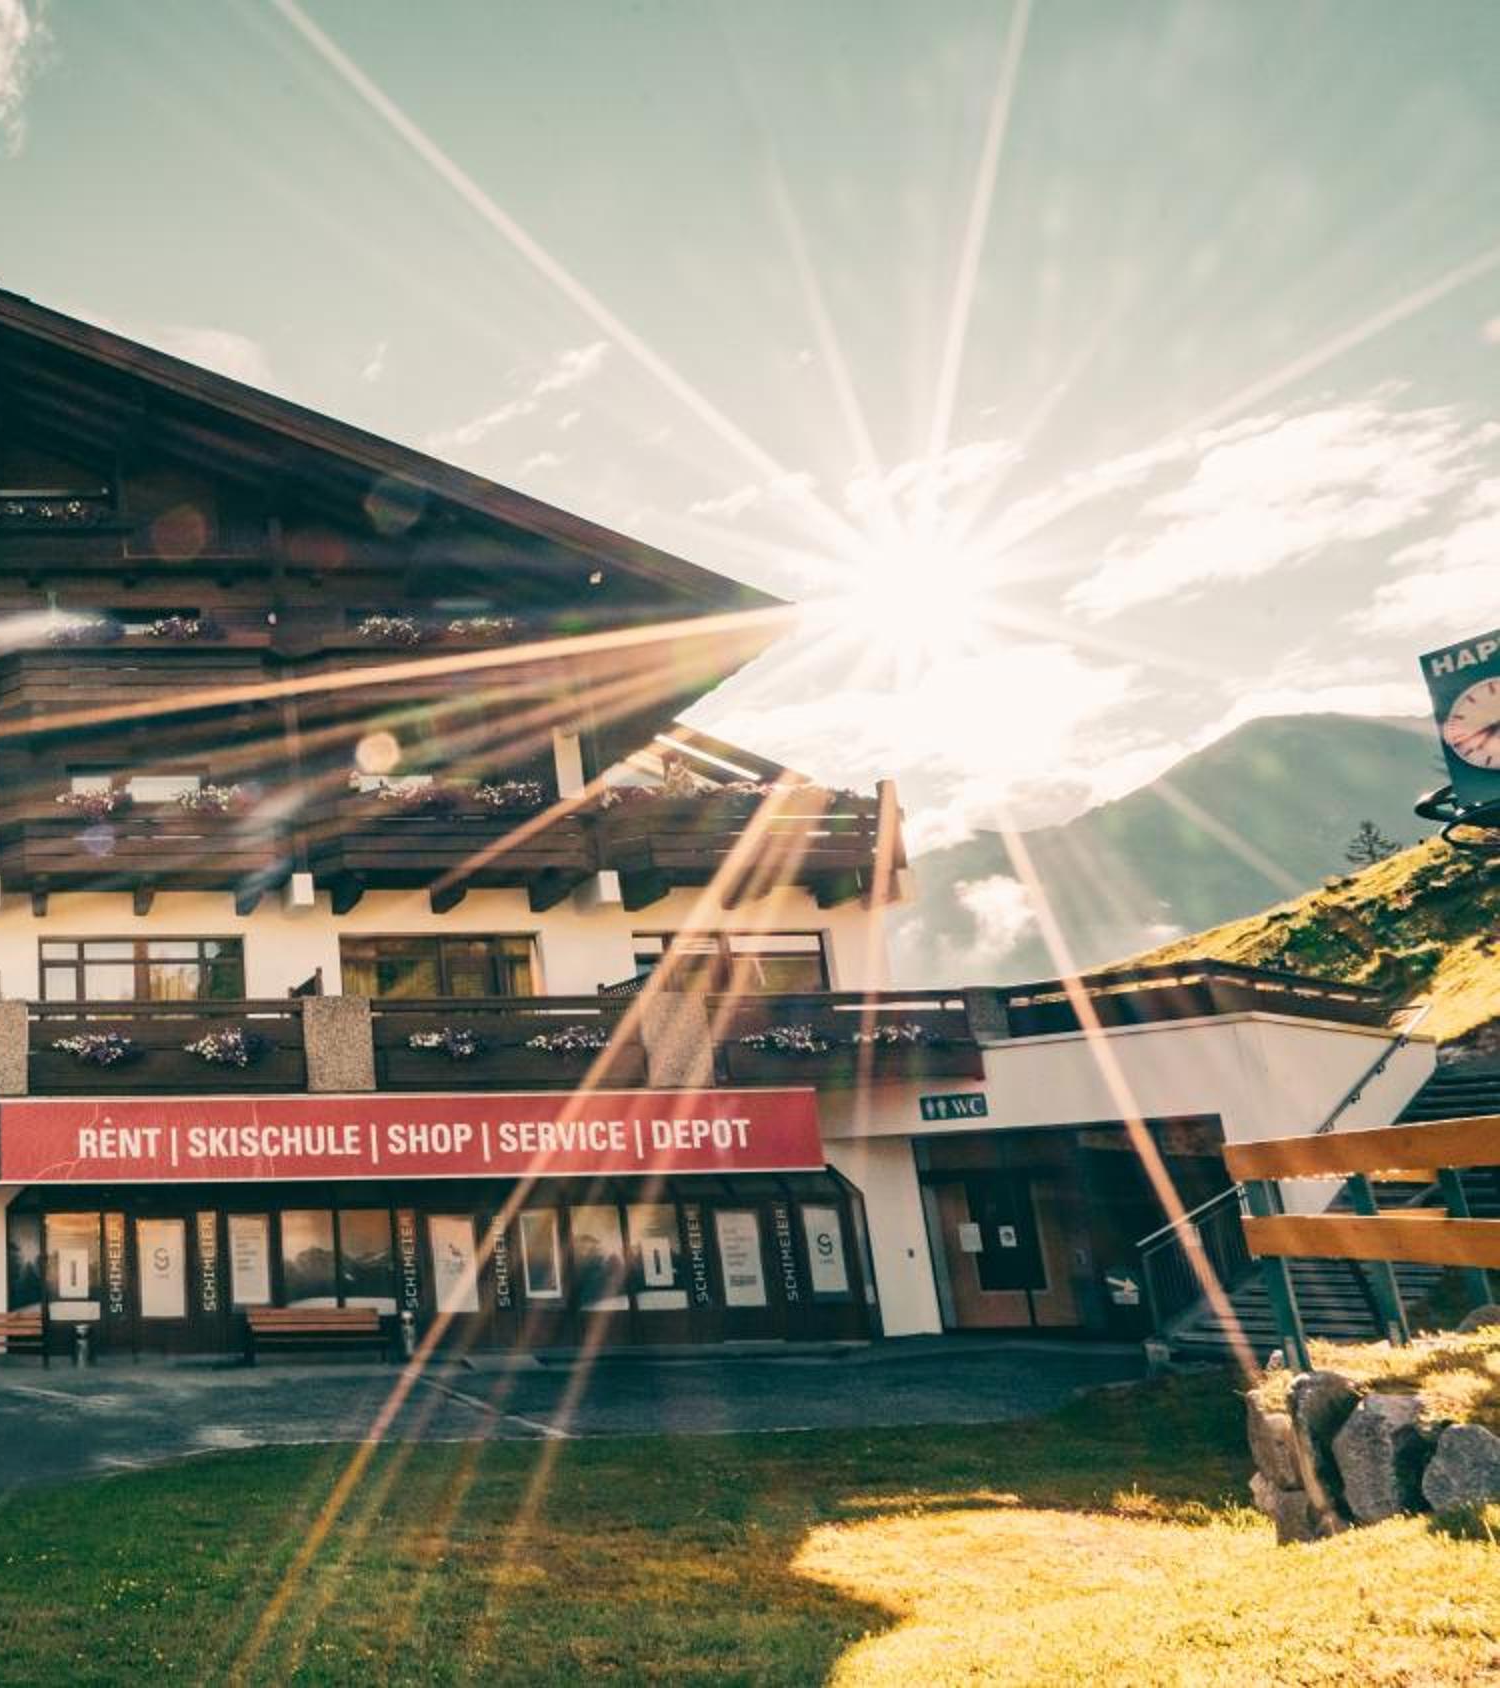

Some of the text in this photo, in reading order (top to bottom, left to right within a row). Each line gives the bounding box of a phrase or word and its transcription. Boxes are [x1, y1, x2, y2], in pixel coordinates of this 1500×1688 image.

[1430, 637, 1500, 677] HAP
[951, 1097, 983, 1115] WC
[187, 1125, 362, 1158] SKISCHULE
[387, 1123, 473, 1154] SHOP
[499, 1120, 627, 1153] SERVICE
[651, 1118, 751, 1150] DEPOT
[109, 1216, 124, 1313] SCHIMEIER
[202, 1217, 217, 1312] SCHIMEIER
